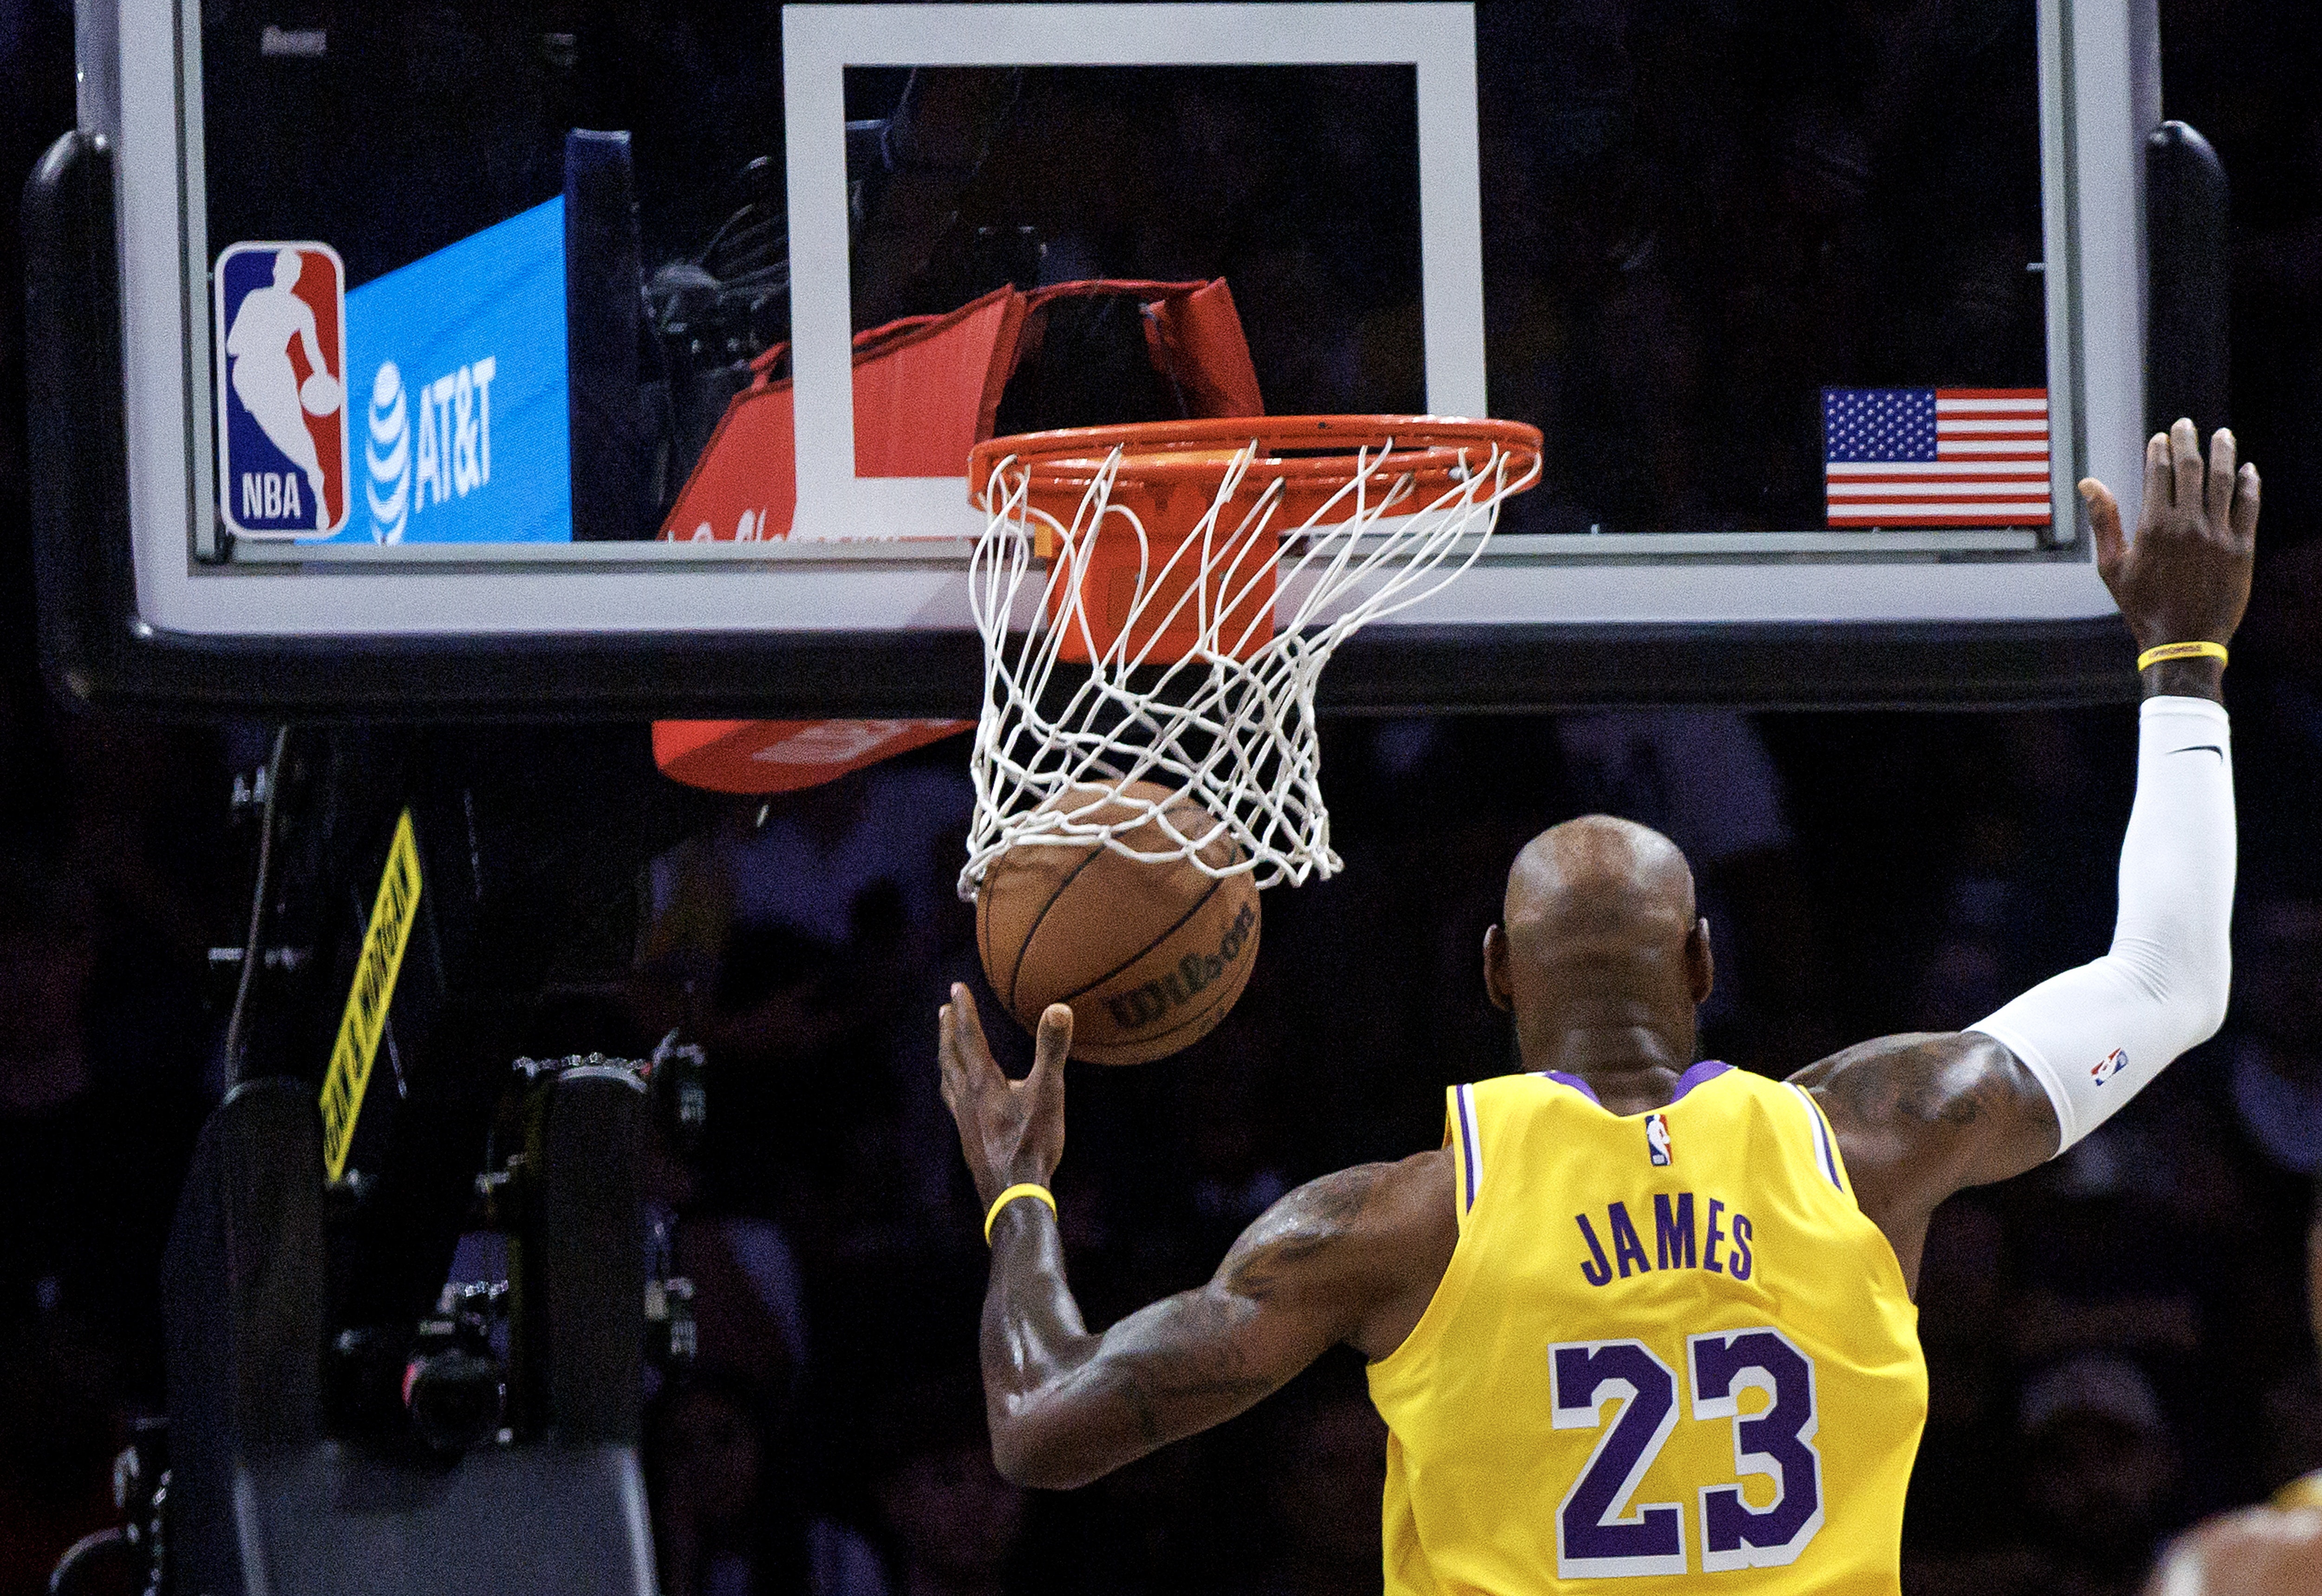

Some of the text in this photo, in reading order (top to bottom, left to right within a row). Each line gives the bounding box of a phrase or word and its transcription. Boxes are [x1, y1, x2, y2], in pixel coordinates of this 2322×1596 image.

[242, 472, 301, 519] NBA
[416, 356, 496, 513] AT&T
[1110, 902, 1253, 1028] Wilson
[1575, 1192, 1753, 1287] JAMES
[1548, 1327, 1825, 1578] 23
